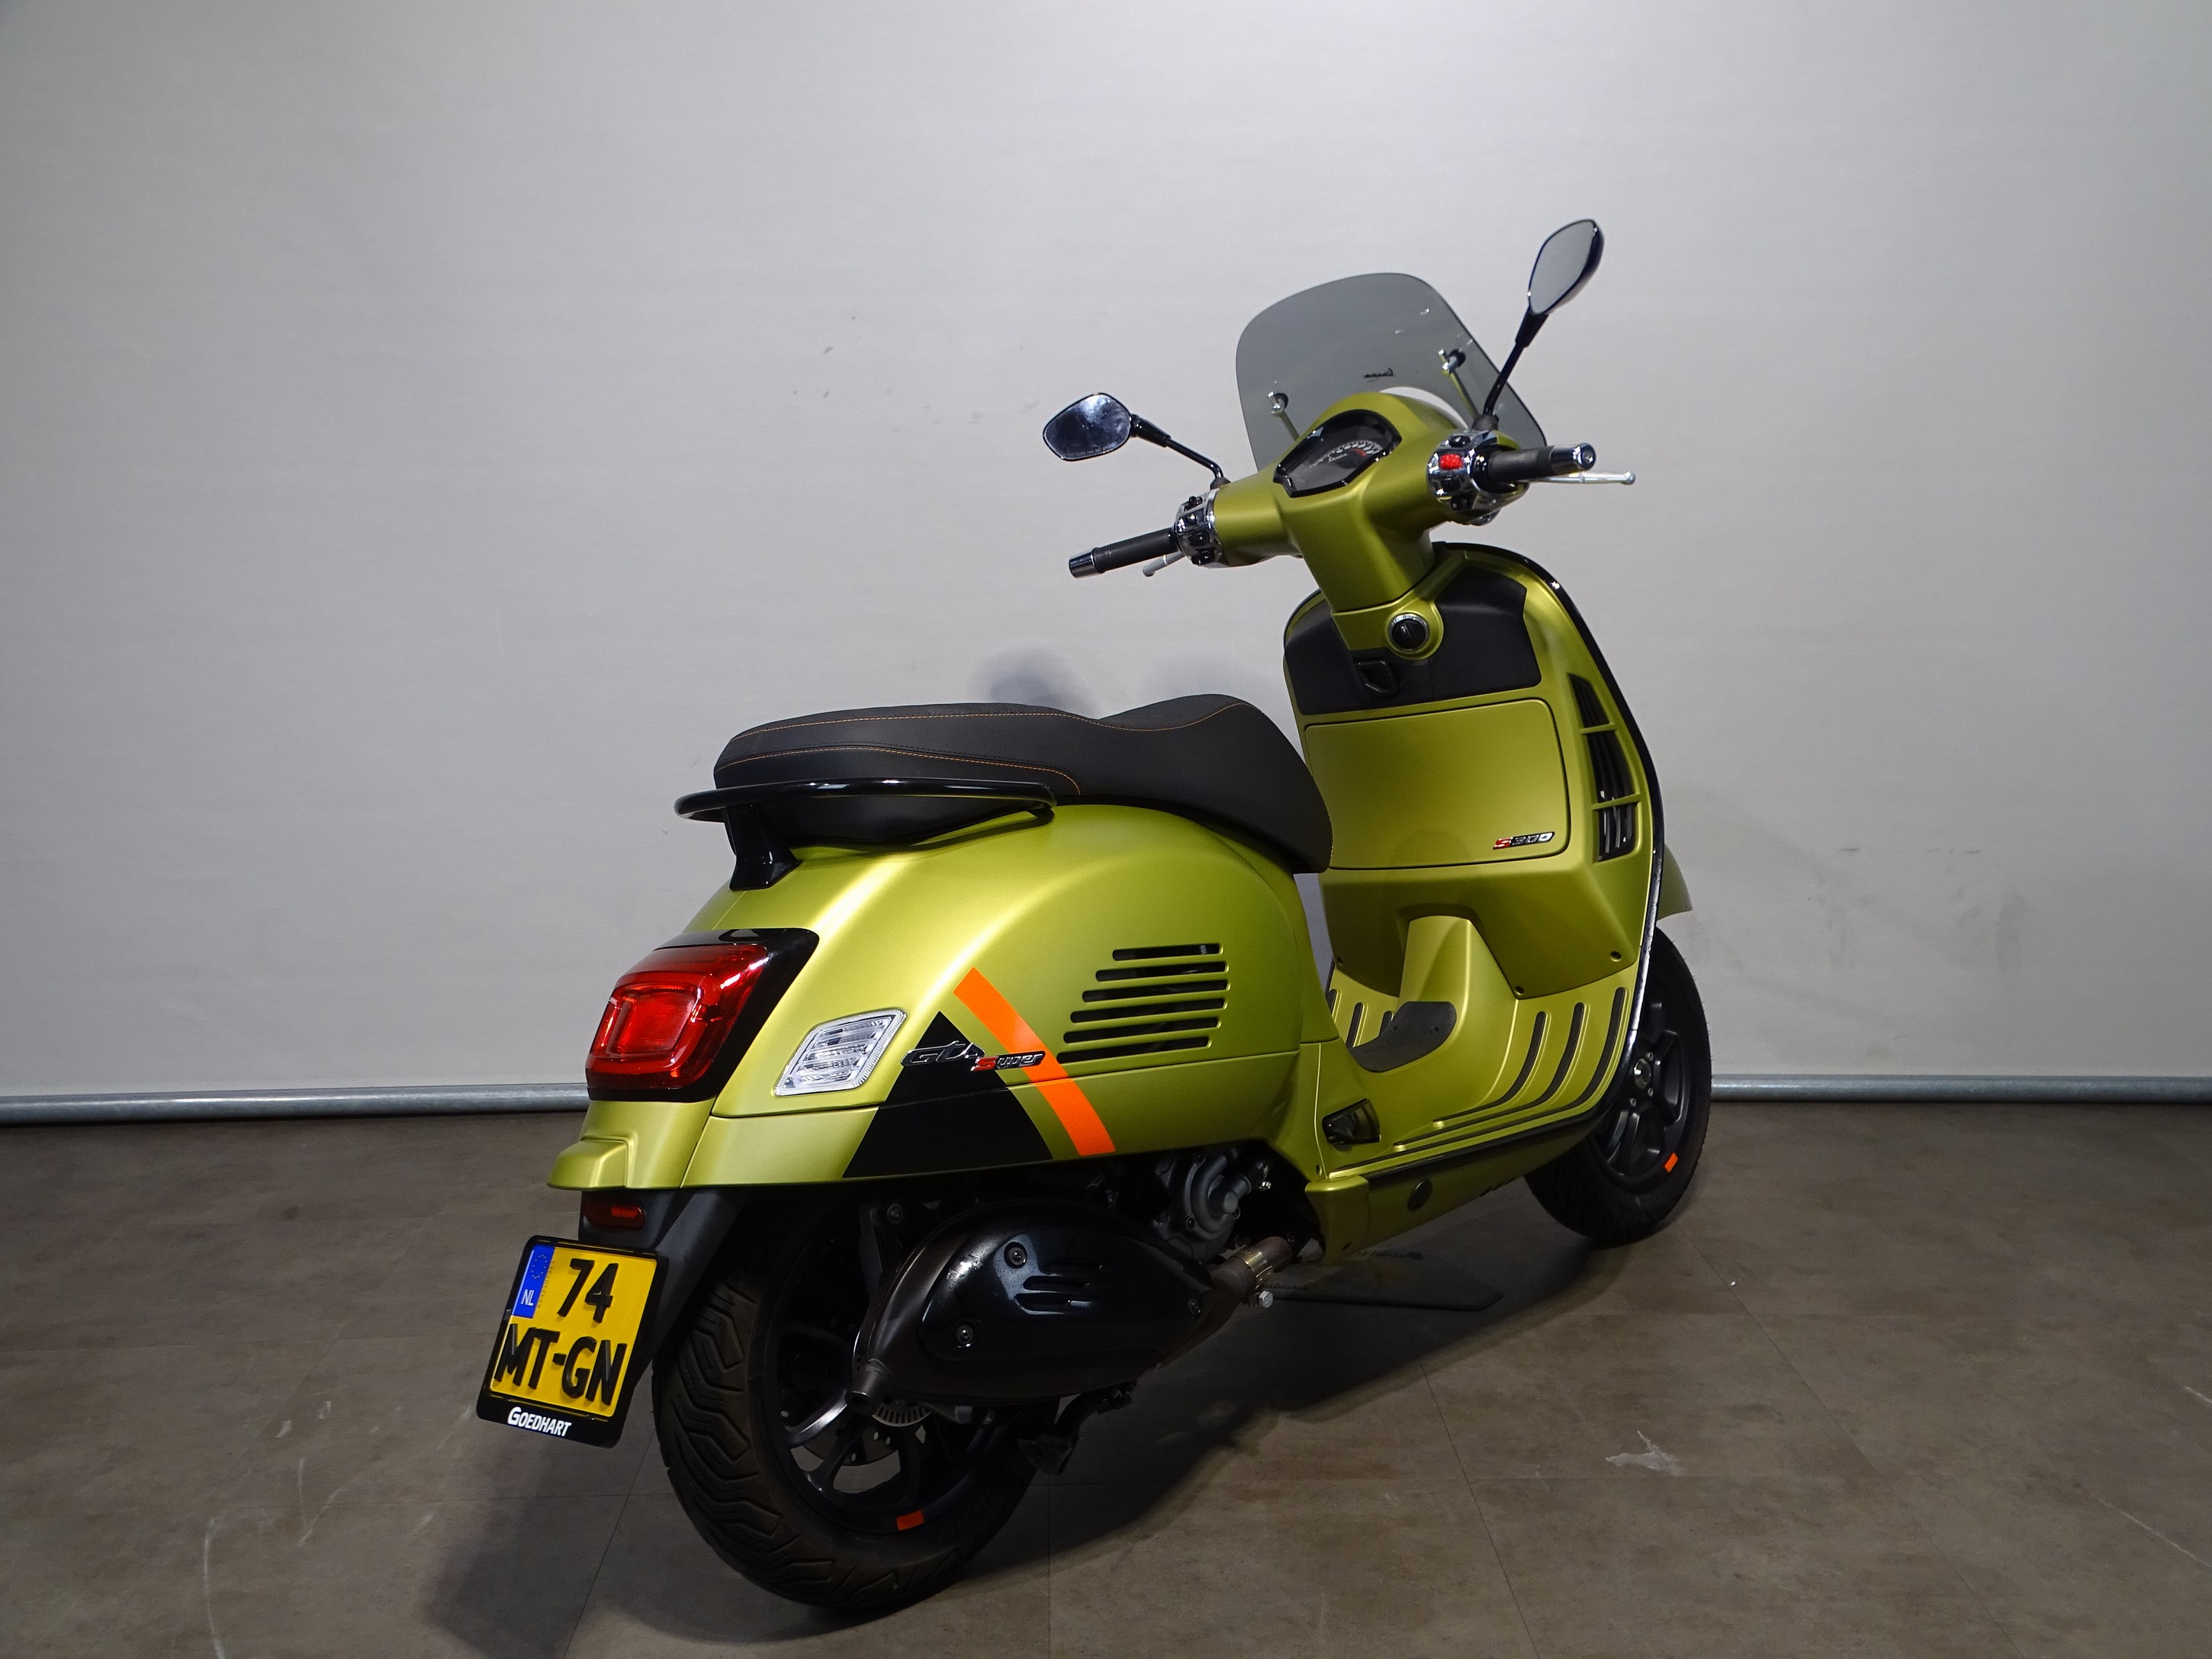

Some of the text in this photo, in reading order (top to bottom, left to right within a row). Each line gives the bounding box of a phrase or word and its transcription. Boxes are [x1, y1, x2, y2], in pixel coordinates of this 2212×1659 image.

[520, 1289, 535, 1307] NL
[558, 1258, 619, 1323] 74
[494, 1323, 628, 1407] MT-GN
